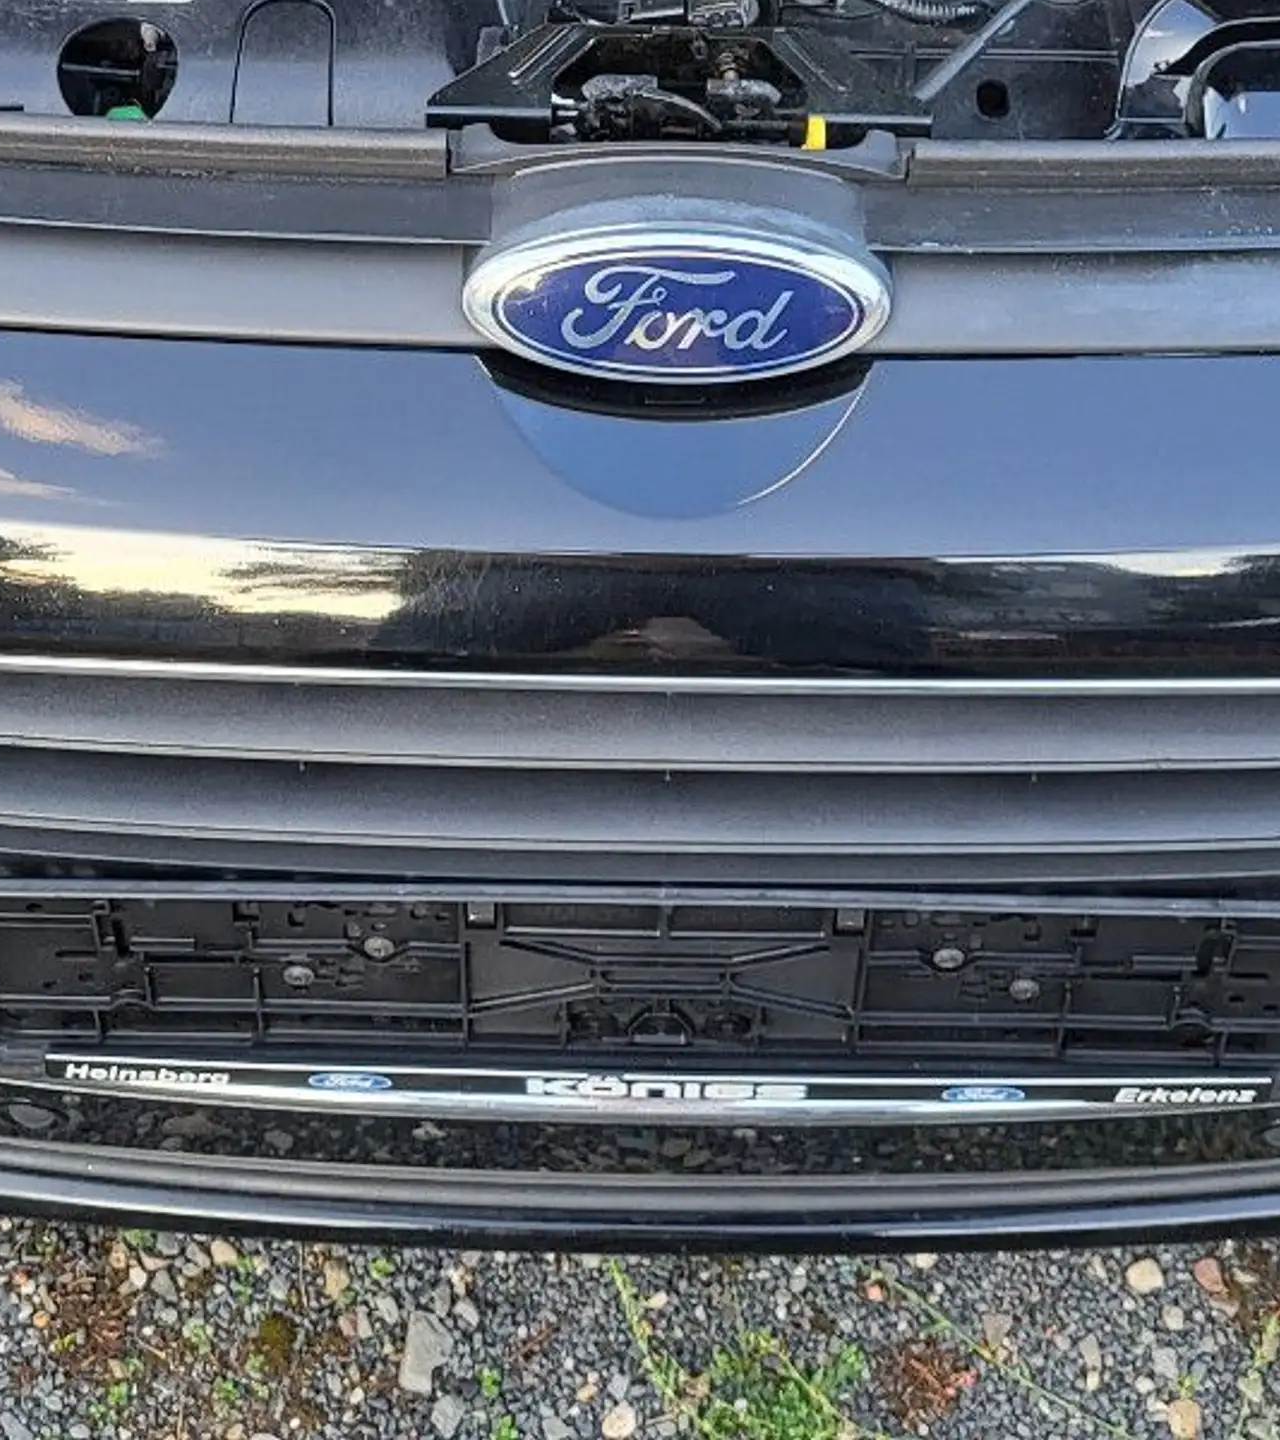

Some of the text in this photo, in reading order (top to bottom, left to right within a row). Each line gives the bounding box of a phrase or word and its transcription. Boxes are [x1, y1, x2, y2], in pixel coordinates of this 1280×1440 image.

[560, 265, 794, 351] Ford
[64, 1062, 231, 1086] Heinsberg
[1113, 1086, 1258, 1104] Erkelenz
